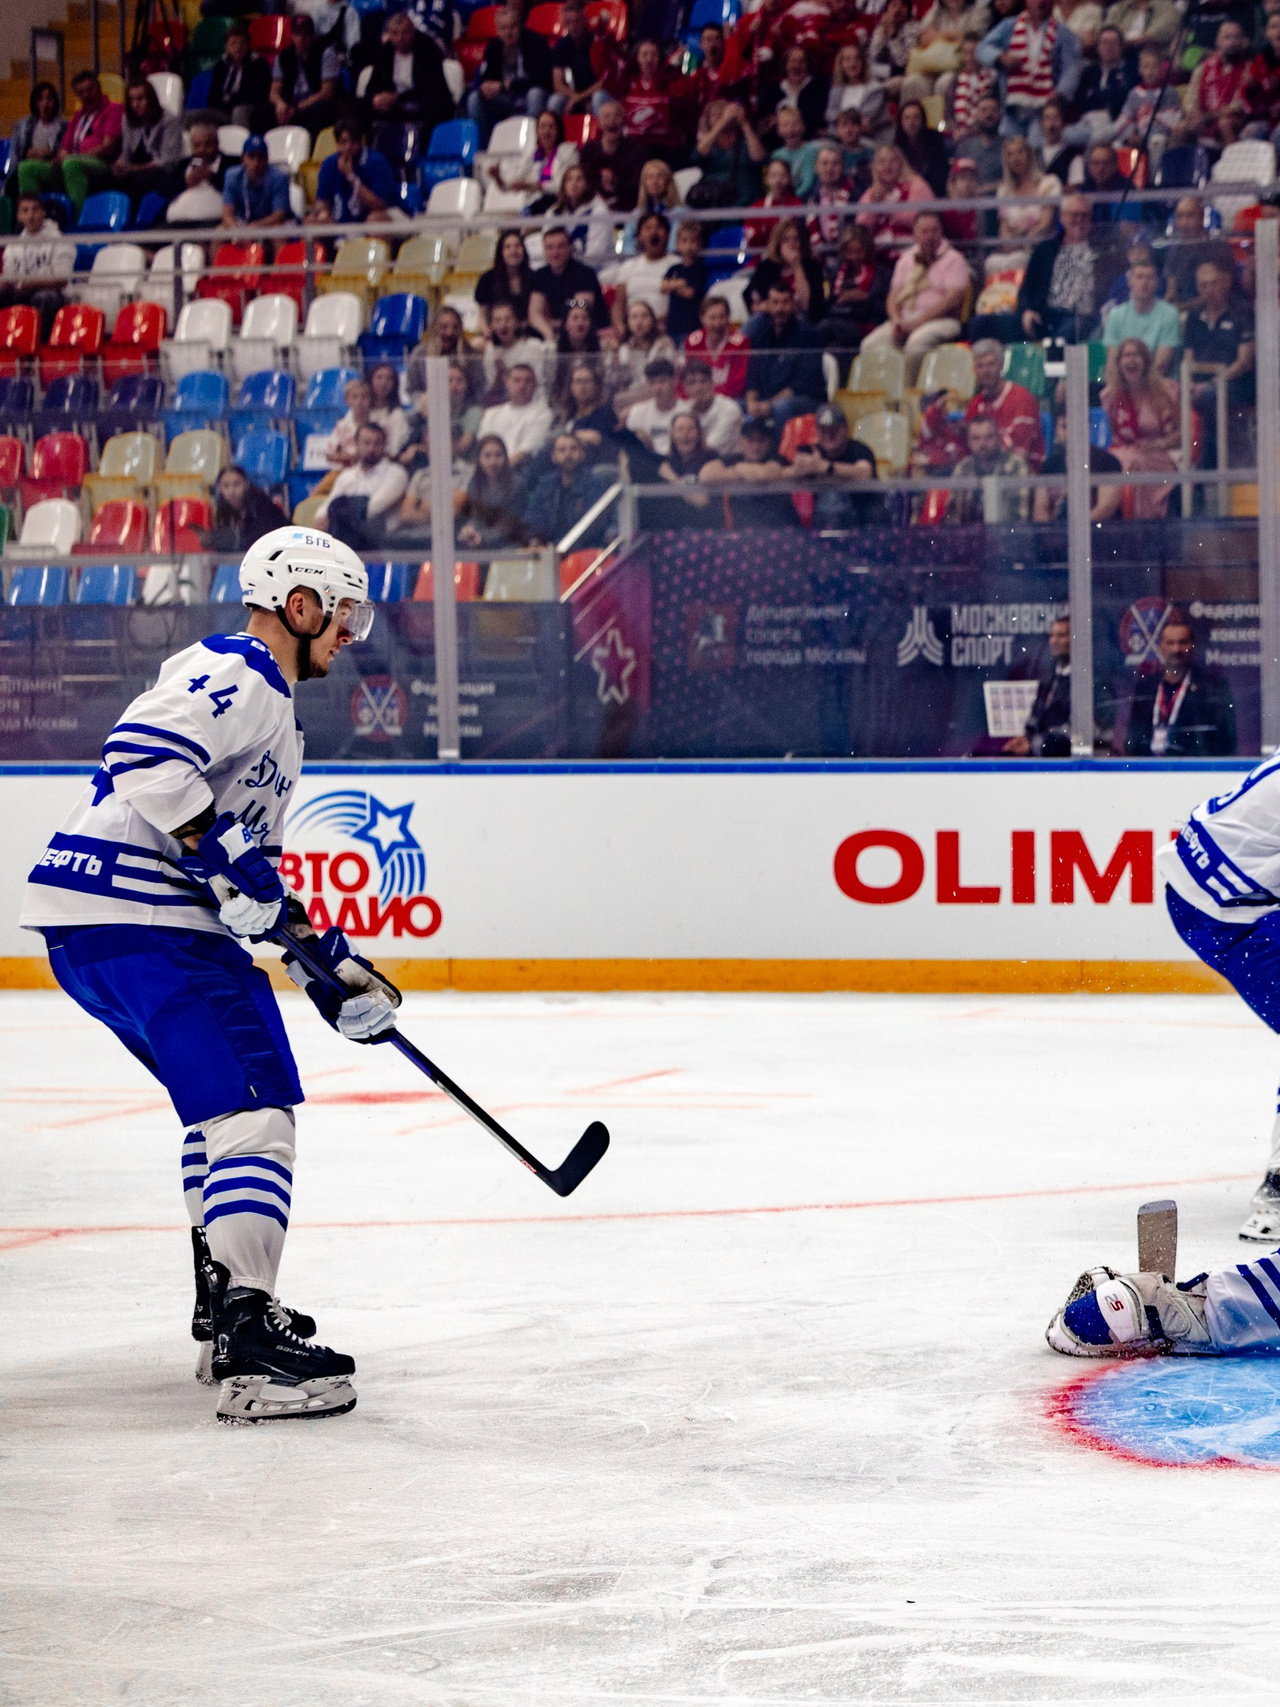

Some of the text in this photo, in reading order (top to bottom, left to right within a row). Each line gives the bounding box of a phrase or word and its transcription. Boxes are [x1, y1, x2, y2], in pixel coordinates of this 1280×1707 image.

[305, 535, 331, 549] ВТБ
[295, 566, 324, 576] CCM
[952, 636, 1013, 666] СПОРТ
[277, 851, 369, 893] ВТО
[305, 895, 442, 938] АДИО
